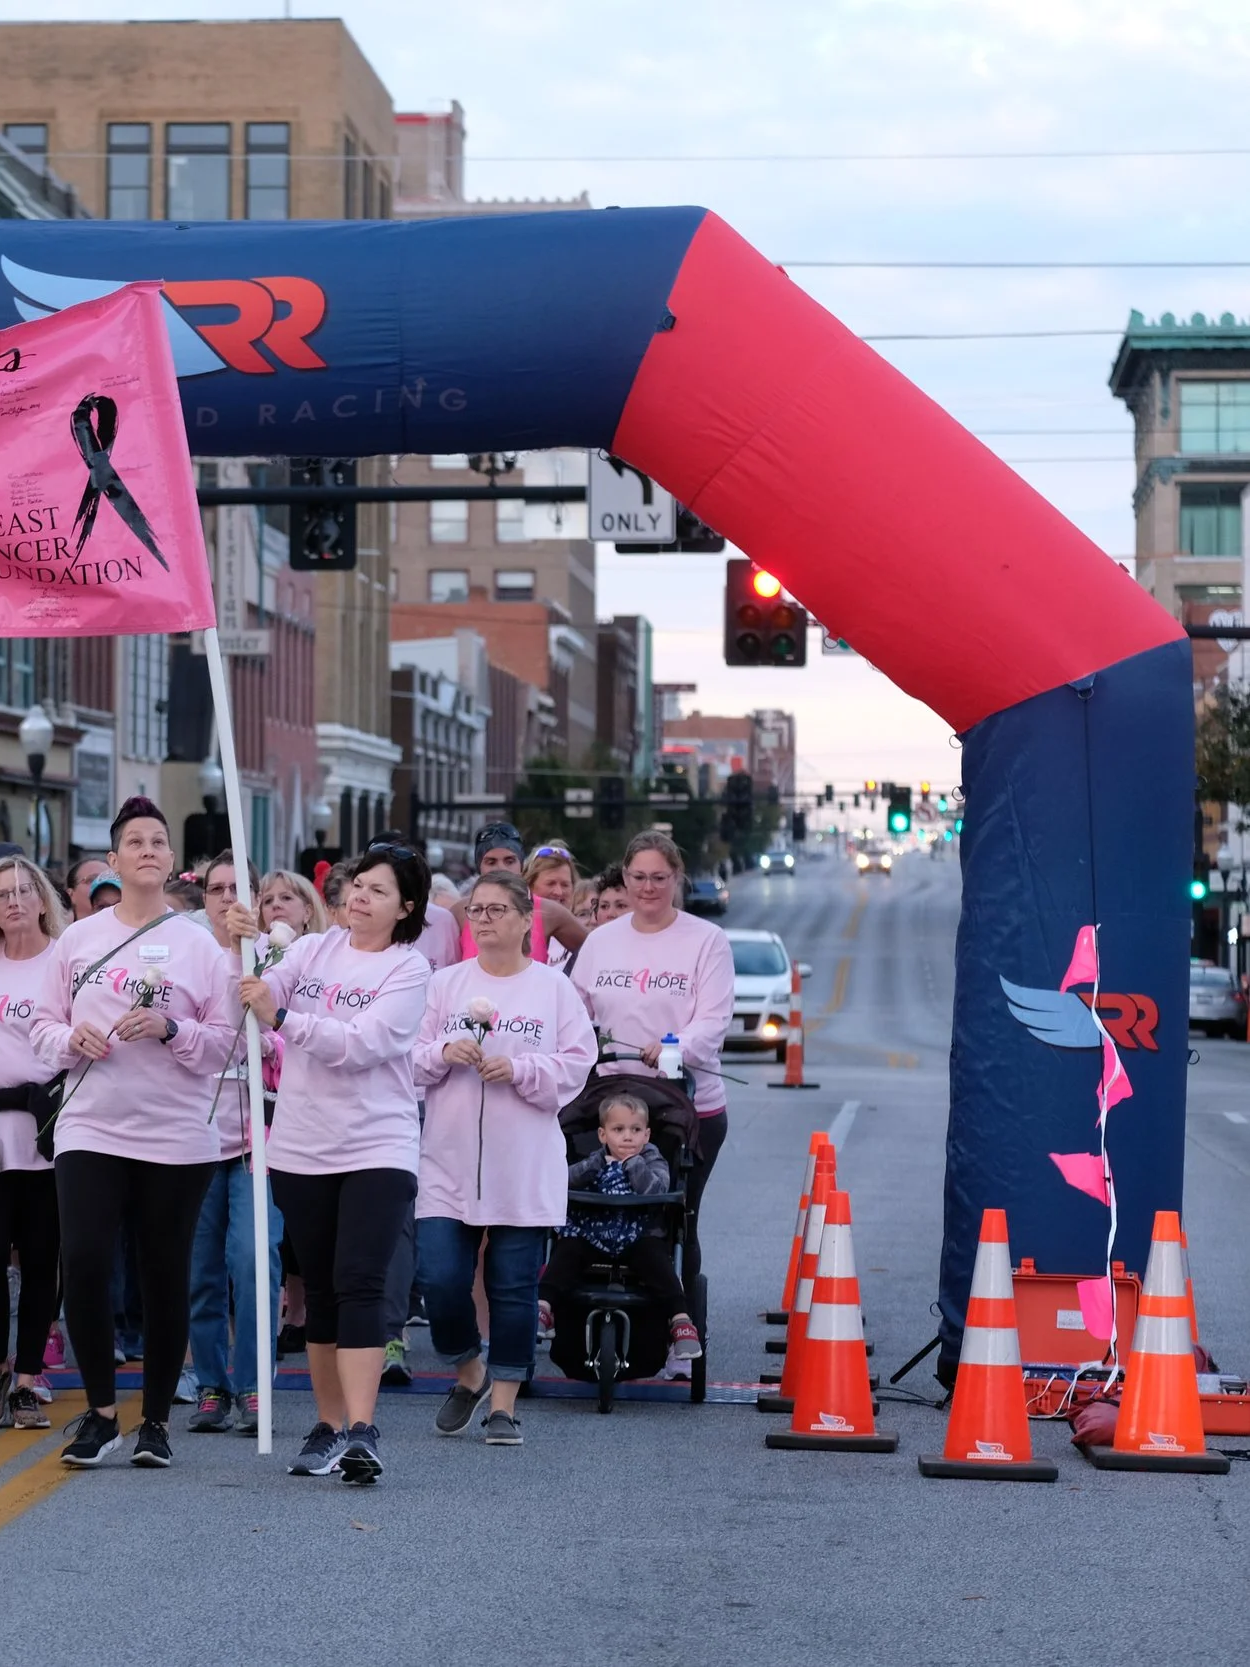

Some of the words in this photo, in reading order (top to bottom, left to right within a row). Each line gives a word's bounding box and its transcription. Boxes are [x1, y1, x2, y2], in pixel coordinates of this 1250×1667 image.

[258, 378, 468, 425] RACING
[601, 512, 662, 533] ONLY
[222, 462, 238, 630] Cristian
[72, 970, 107, 988] RCE
[595, 974, 634, 988] RACE
[648, 975, 688, 991] HOPE
[336, 990, 375, 1009] HOP
[5, 1002, 35, 1019] HO
[1077, 992, 1159, 1050] RR
[497, 1019, 544, 1040] HOPE
